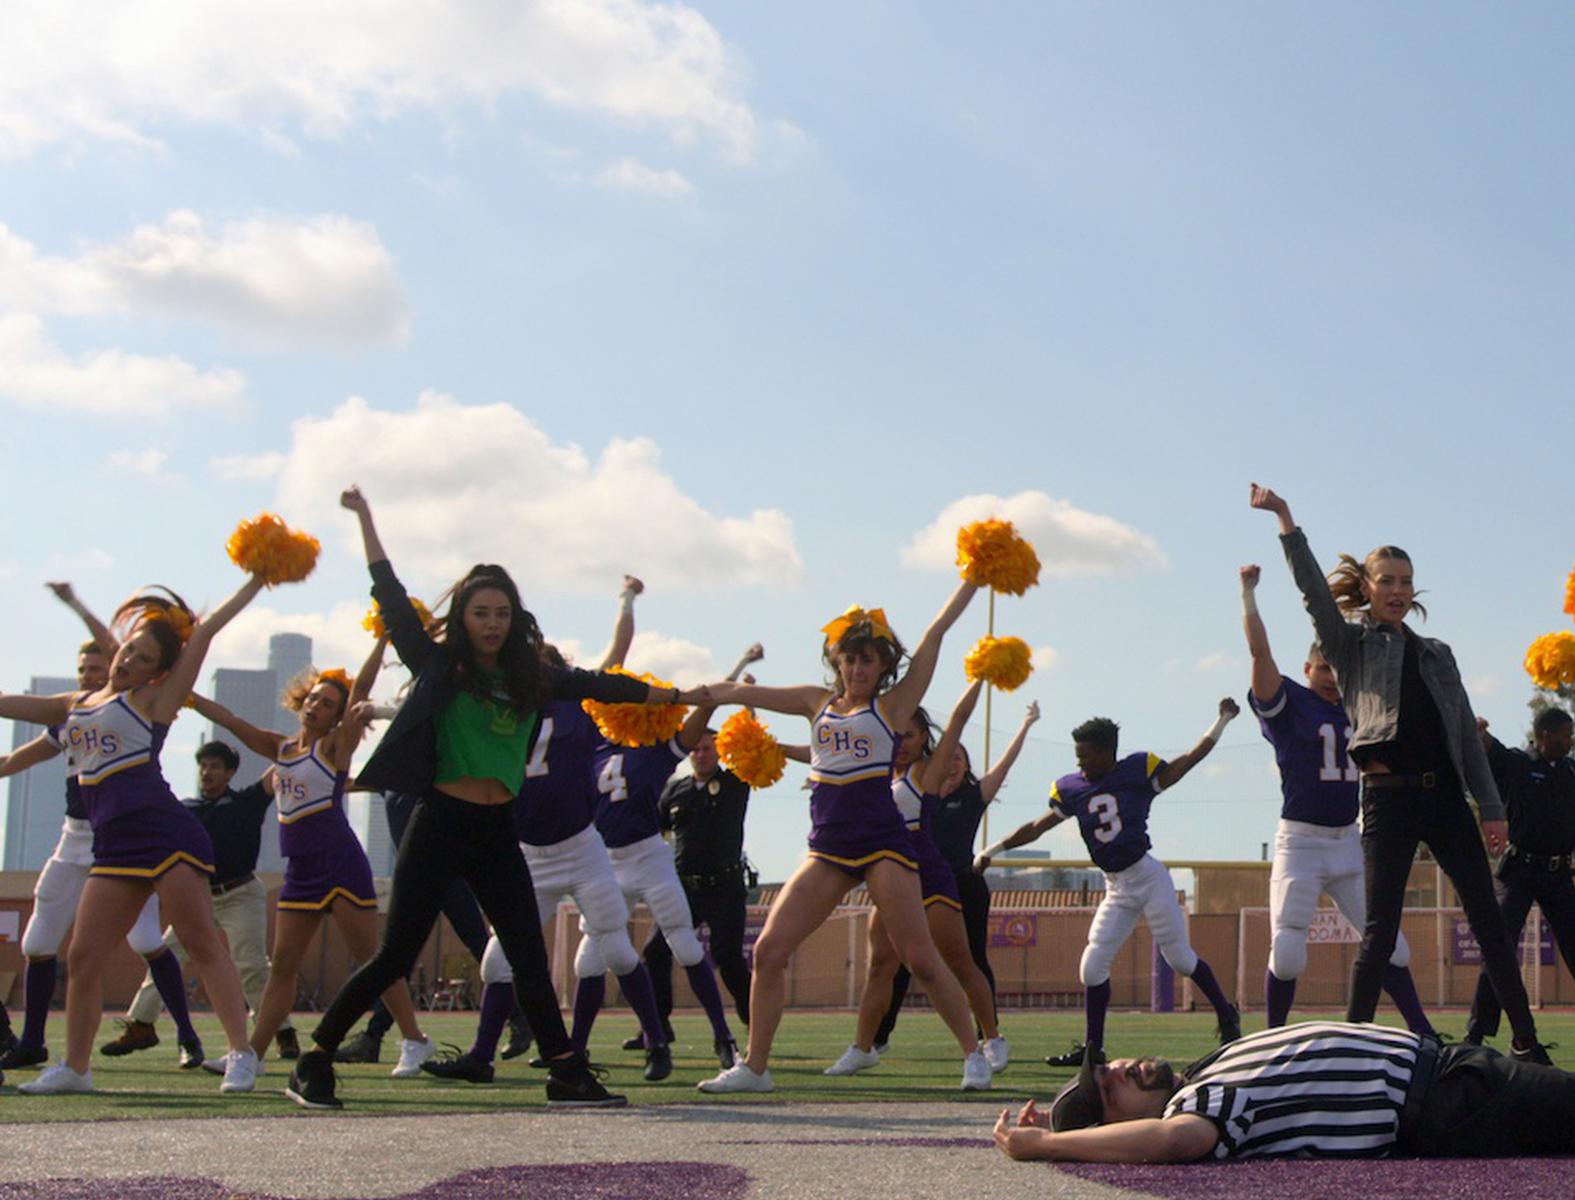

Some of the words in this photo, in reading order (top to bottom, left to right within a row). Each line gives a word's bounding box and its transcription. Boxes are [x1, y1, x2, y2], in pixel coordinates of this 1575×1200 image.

[68, 725, 120, 756] CHS
[817, 724, 872, 760] CHS
[597, 754, 629, 802] 4
[1087, 793, 1124, 844] 3
